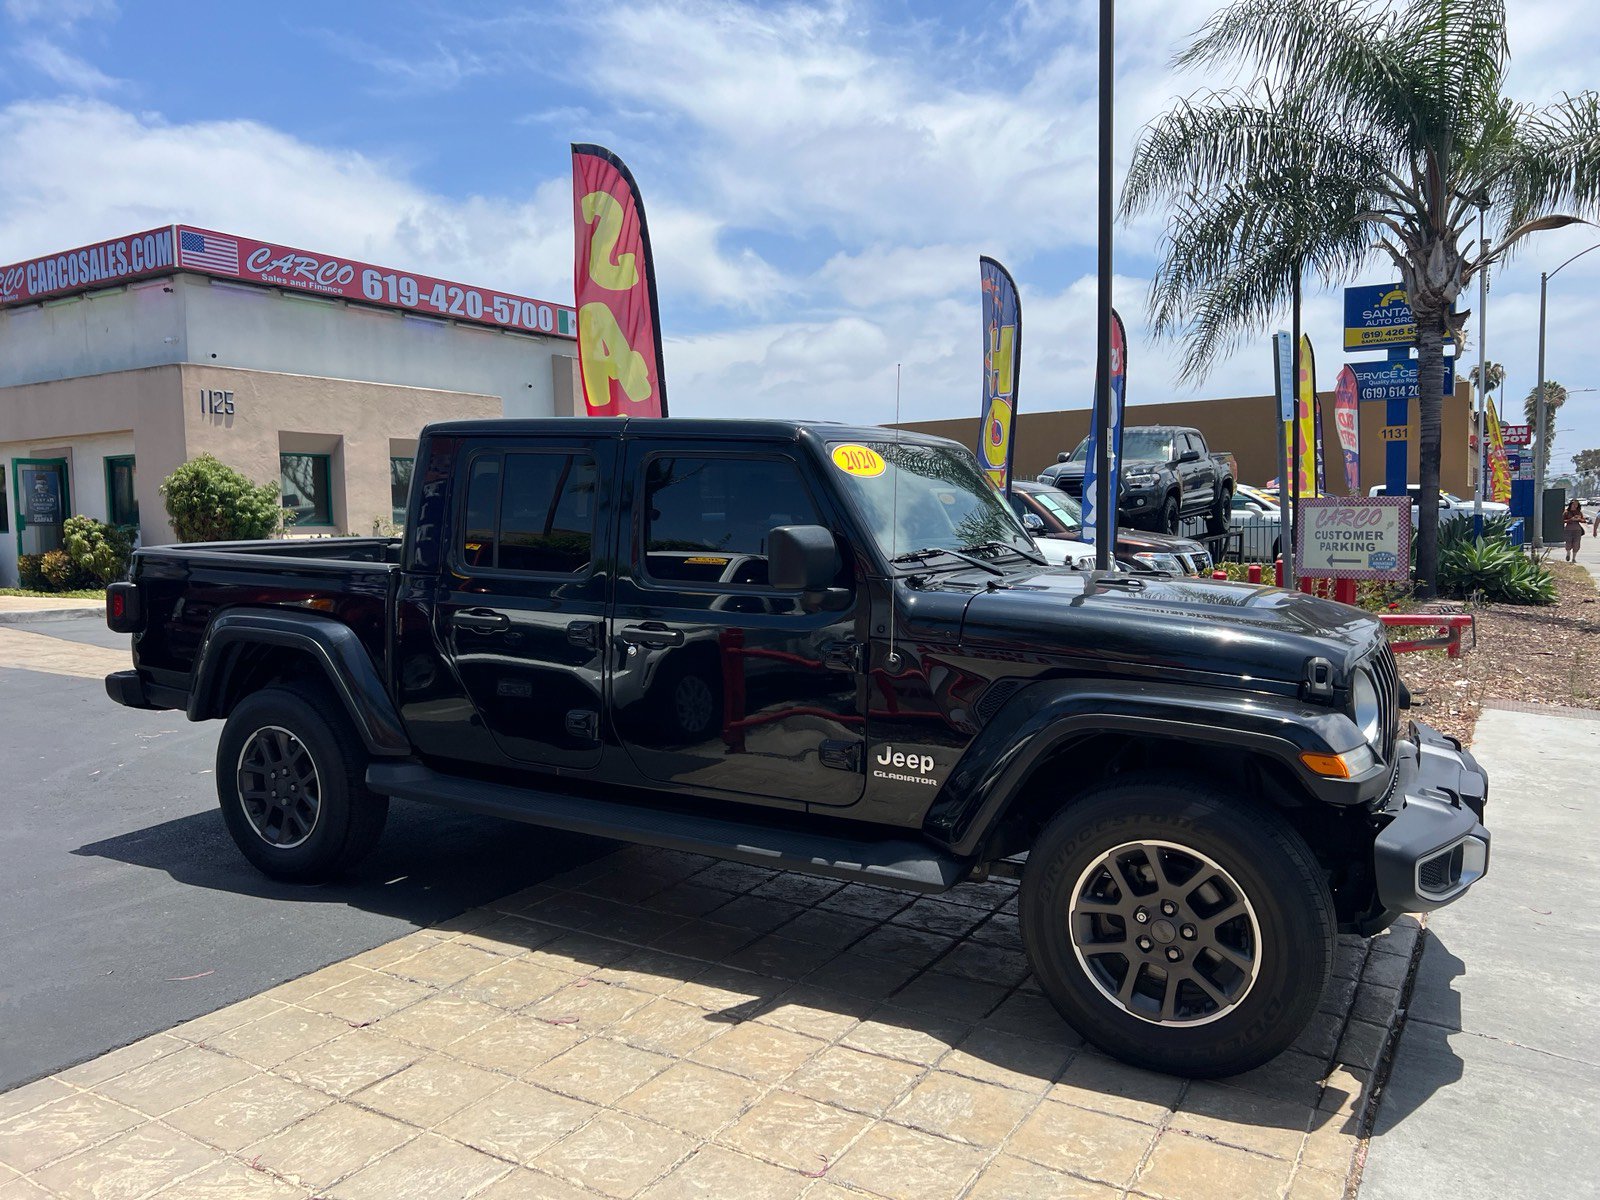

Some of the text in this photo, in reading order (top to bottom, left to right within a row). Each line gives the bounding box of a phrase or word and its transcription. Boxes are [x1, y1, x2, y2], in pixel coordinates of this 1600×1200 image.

[26, 231, 173, 296] CARCOSALES.COM
[246, 247, 355, 285] CARCO
[261, 273, 343, 295] Sales and Finance
[361, 269, 554, 332] 619-420-5700
[1362, 307, 1413, 320] SANTA
[1365, 318, 1392, 327] AUTO
[1361, 330, 1384, 339] (619)
[1385, 328, 1405, 336] 426
[1356, 370, 1398, 381] ERVICE
[1362, 386, 1387, 399] (619)
[1388, 385, 1406, 397] 614
[200, 389, 234, 414] 1125
[1381, 427, 1408, 439] 1131
[841, 450, 877, 470] 2020
[1315, 507, 1383, 529] CARCO
[1314, 530, 1384, 541] CUSTOMER
[1320, 541, 1376, 552] PARKING
[877, 746, 935, 774] Jeep
[873, 770, 938, 786] GLADIATOR
